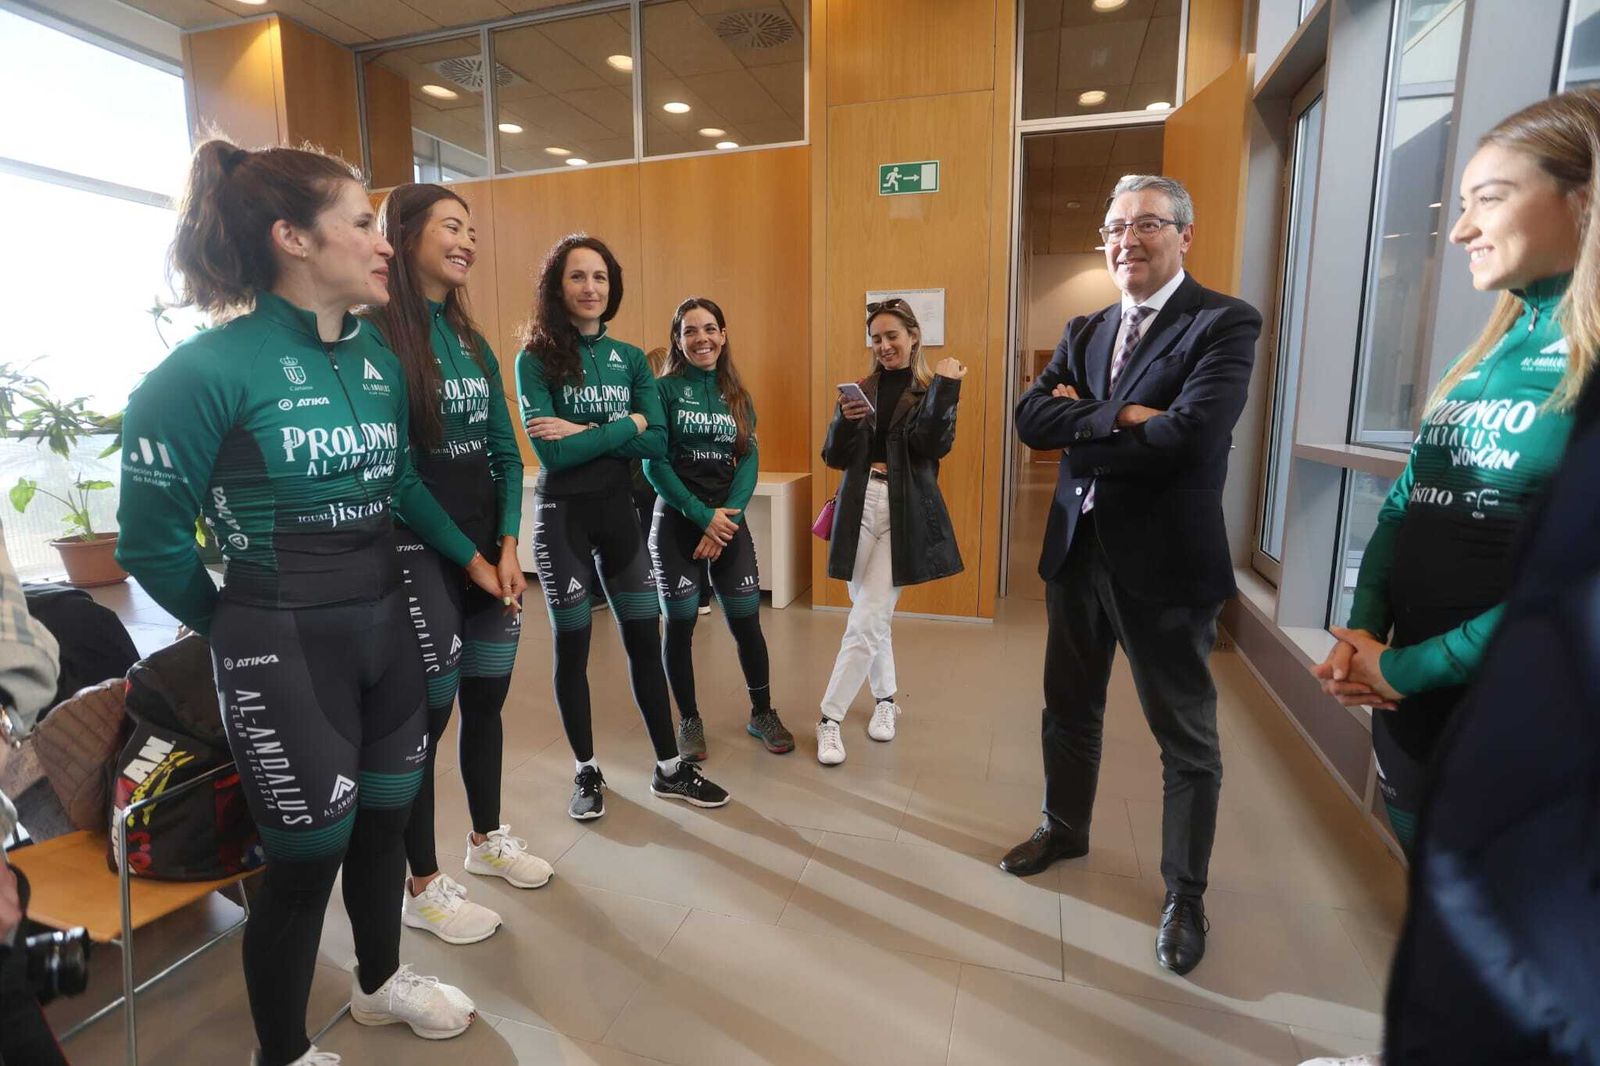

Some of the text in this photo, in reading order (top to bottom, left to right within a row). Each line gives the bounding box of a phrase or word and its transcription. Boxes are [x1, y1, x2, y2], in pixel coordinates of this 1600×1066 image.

[296, 396, 331, 408] ATIKA
[563, 384, 631, 405] PROLONGO
[280, 422, 398, 463] PROLONG
[235, 653, 280, 668] ATIKA
[235, 689, 313, 825] AL-ANDALUS
